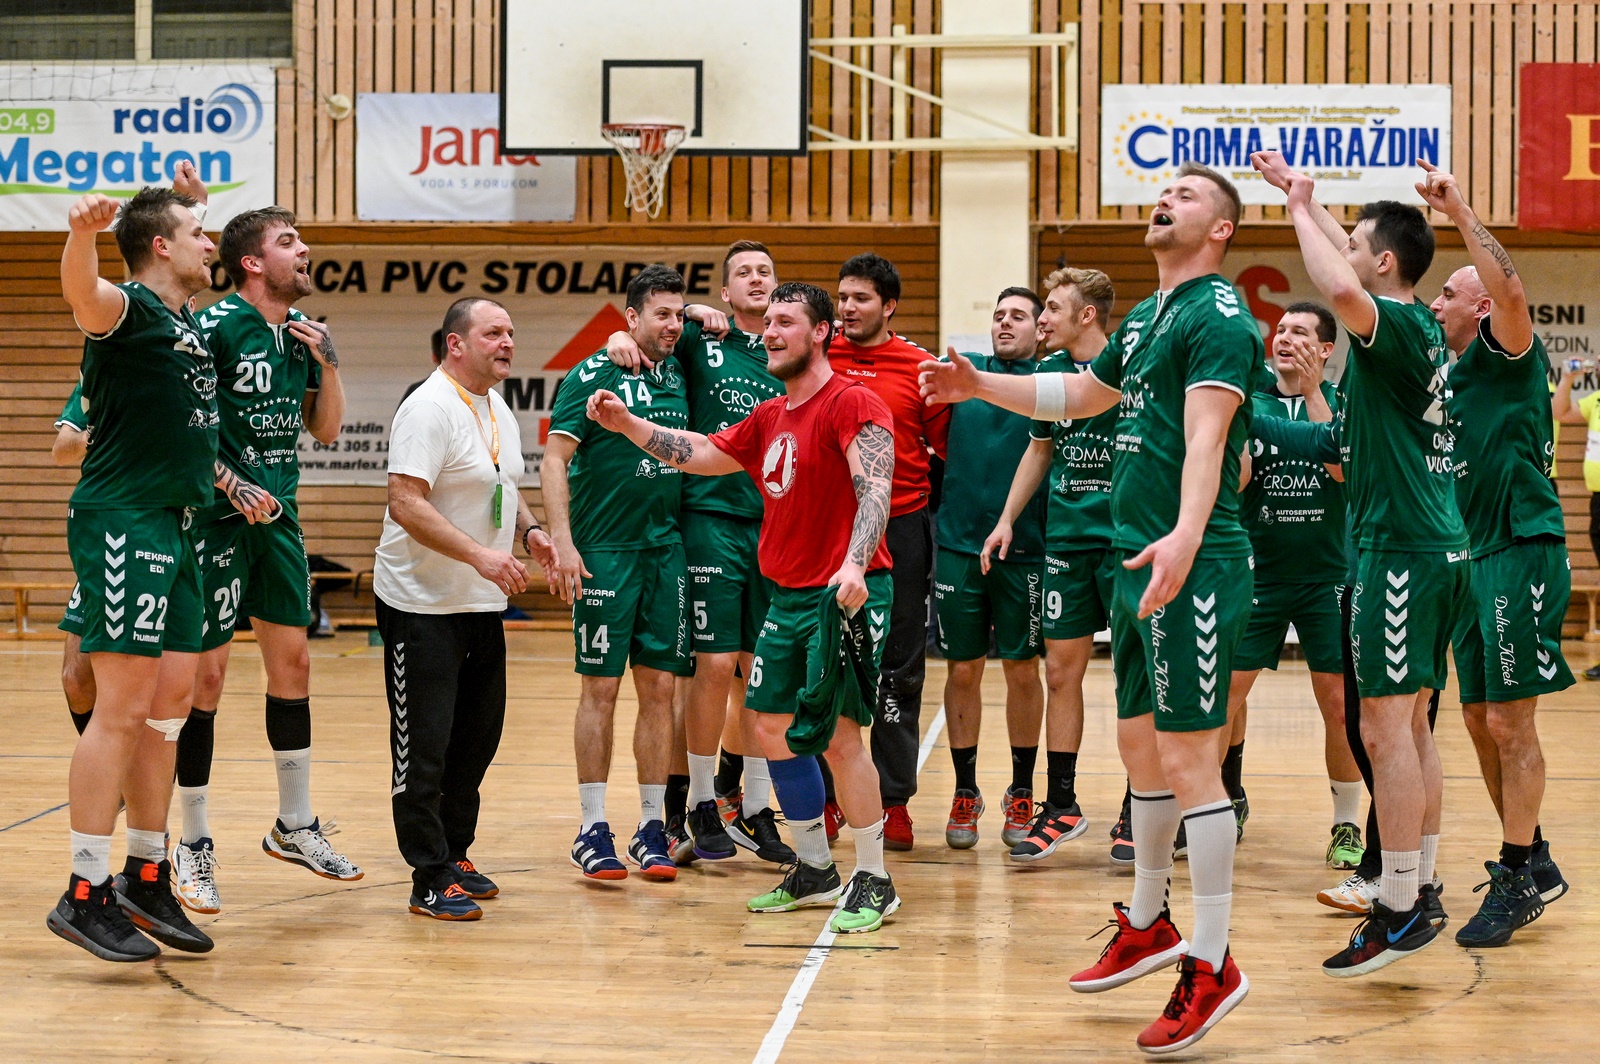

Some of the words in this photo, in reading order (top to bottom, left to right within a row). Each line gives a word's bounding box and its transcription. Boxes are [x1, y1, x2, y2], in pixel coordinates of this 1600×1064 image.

[113, 96, 232, 134] radio
[409, 126, 541, 175] Jan
[0, 137, 231, 191] Megaton
[420, 179, 455, 188] VODA
[460, 179, 468, 188] S
[382, 260, 468, 293] PVC
[706, 341, 724, 368] 5
[232, 361, 272, 393] 20
[618, 380, 653, 408] 14
[1062, 445, 1111, 461] CROMA
[1263, 475, 1321, 490] CROMA
[1276, 508, 1325, 516] AUTOSERVISNI
[135, 550, 175, 564] PEKARA
[149, 564, 165, 574] EDI
[694, 575, 710, 583] EDI
[1047, 566, 1059, 575] EDI
[214, 578, 241, 621] 20
[582, 588, 616, 598] EKARA
[586, 598, 603, 606] EDI
[134, 593, 168, 630] 22
[693, 600, 708, 630] 5
[133, 631, 160, 643] hummel
[578, 623, 610, 654] 14
